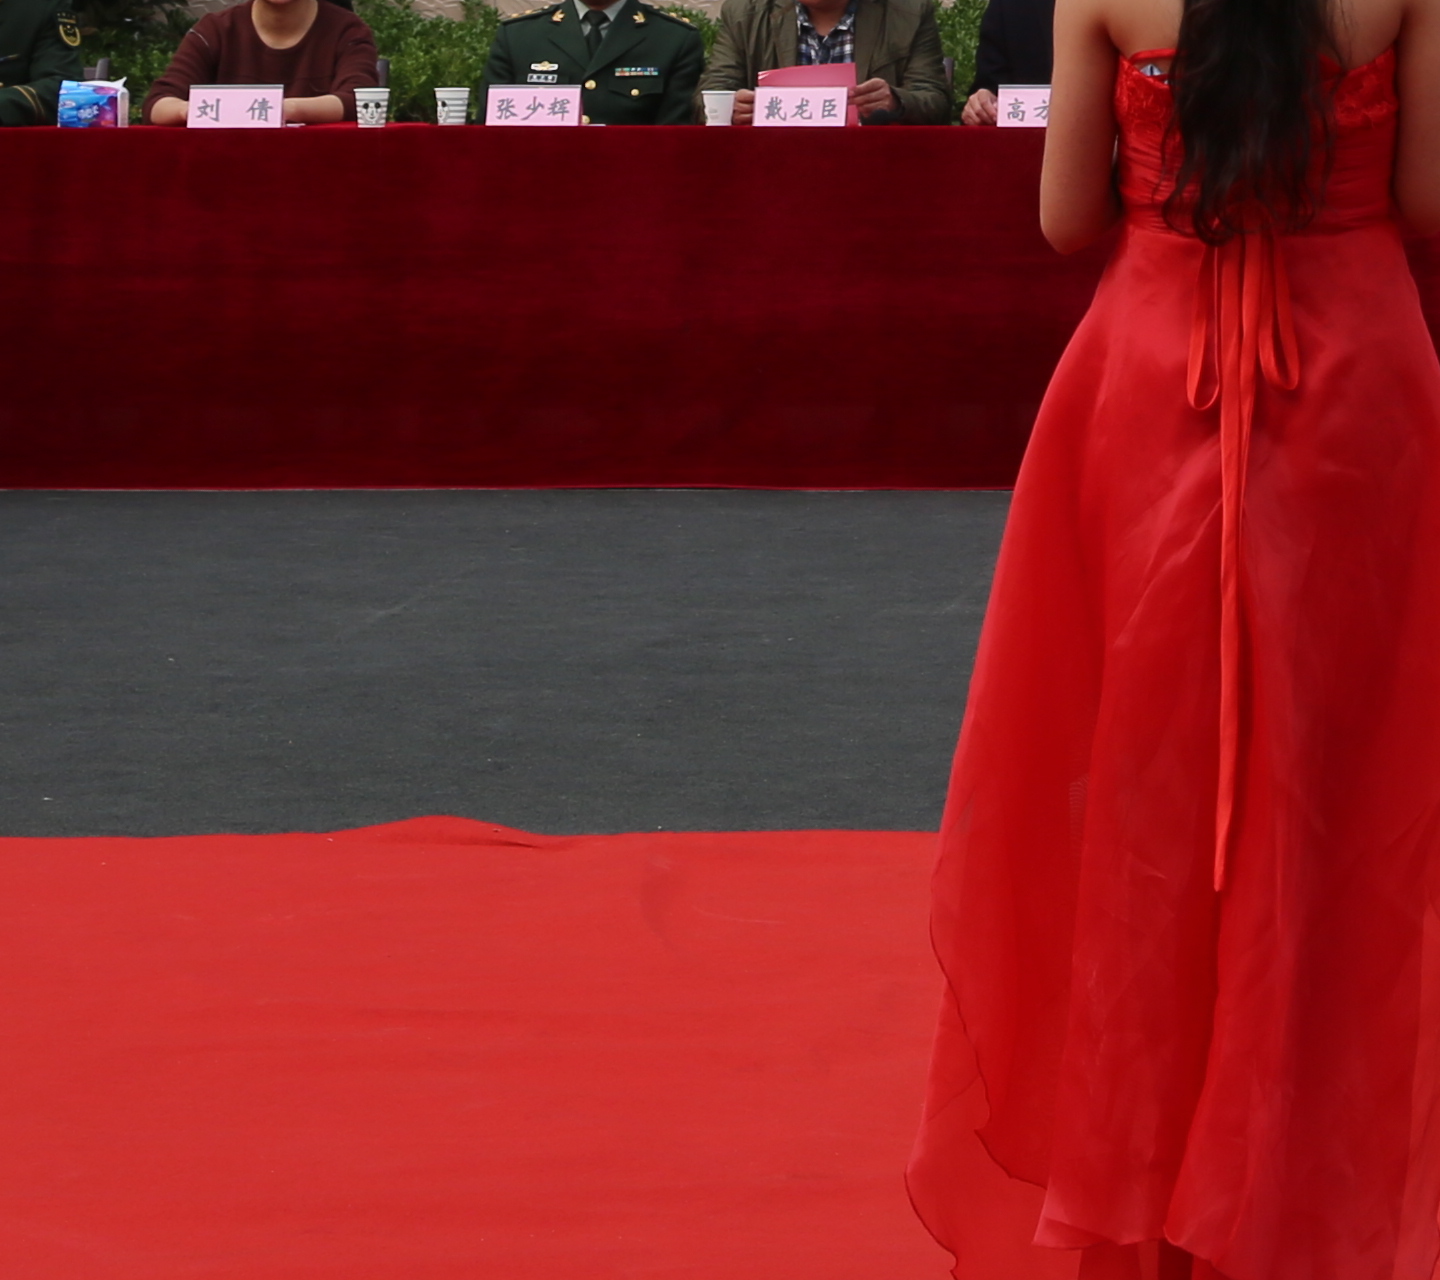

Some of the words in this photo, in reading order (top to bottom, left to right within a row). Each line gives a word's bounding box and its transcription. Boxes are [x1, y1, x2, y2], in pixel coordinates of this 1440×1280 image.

[496, 96, 571, 122] 张少辉
[764, 96, 839, 122] 戴龙臣
